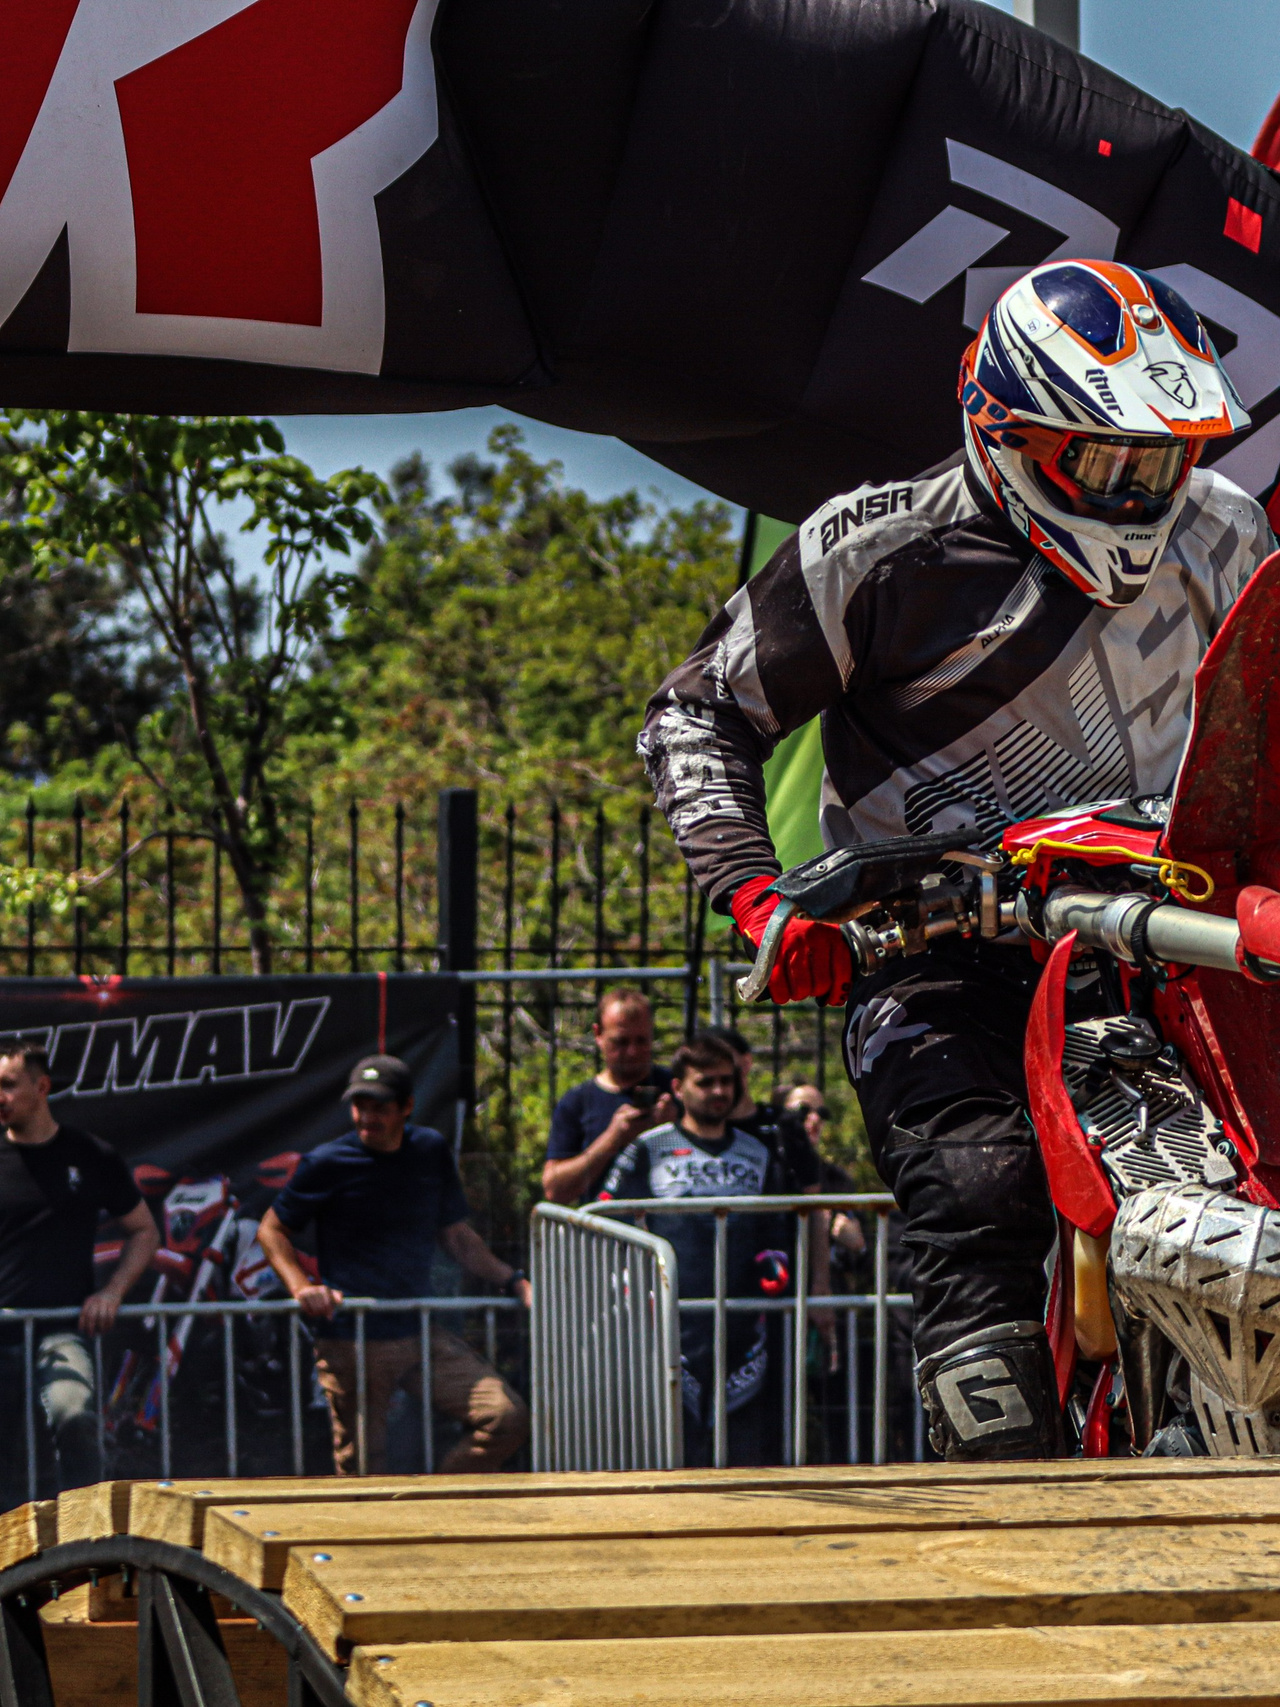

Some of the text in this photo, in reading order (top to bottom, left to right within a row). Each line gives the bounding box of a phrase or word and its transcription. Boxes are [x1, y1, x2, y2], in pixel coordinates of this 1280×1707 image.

[1085, 368, 1124, 417] thor
[821, 487, 914, 557] ANSR
[1124, 530, 1157, 541] thor
[981, 614, 1015, 650] ALPHA
[0, 996, 331, 1100] UMAV
